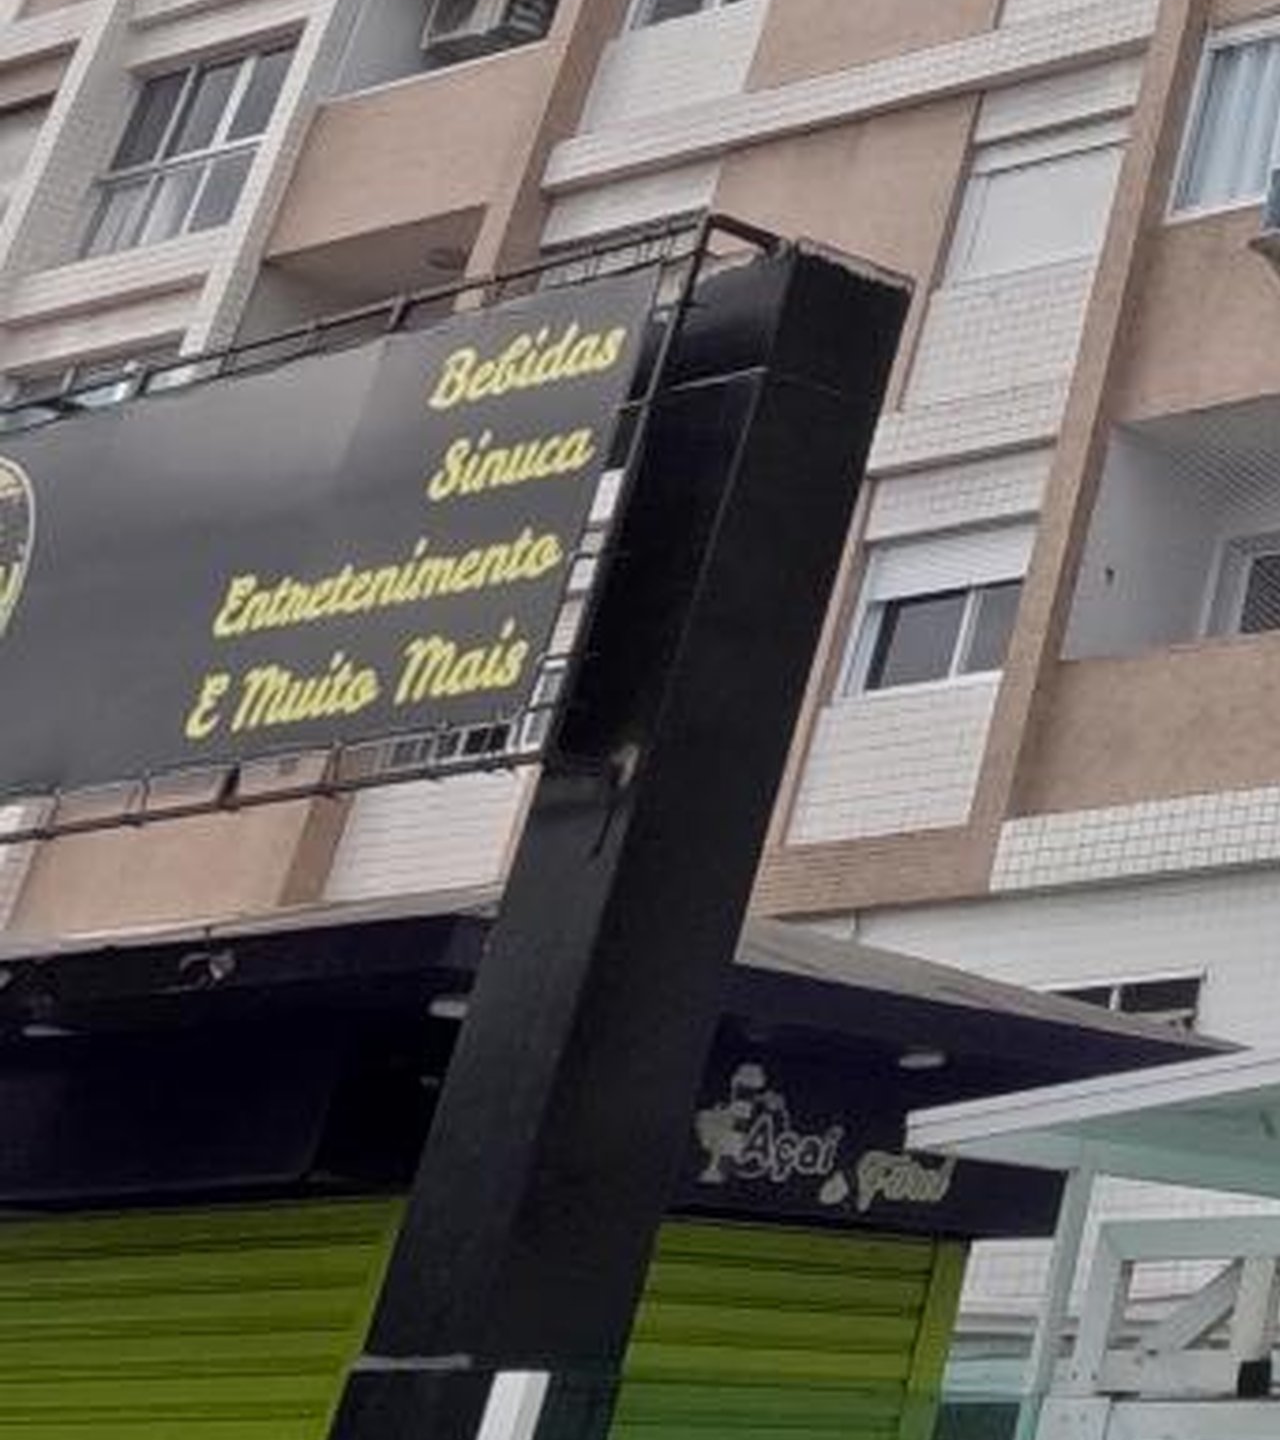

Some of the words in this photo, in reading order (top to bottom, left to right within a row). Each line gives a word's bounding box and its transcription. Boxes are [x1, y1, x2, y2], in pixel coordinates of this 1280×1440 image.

[429, 324, 627, 409] Bebidas
[428, 431, 596, 501] Sinuca
[213, 527, 563, 636] Entretenimento
[185, 672, 231, 739] E
[232, 651, 380, 733] Muito
[394, 617, 530, 705] Mais
